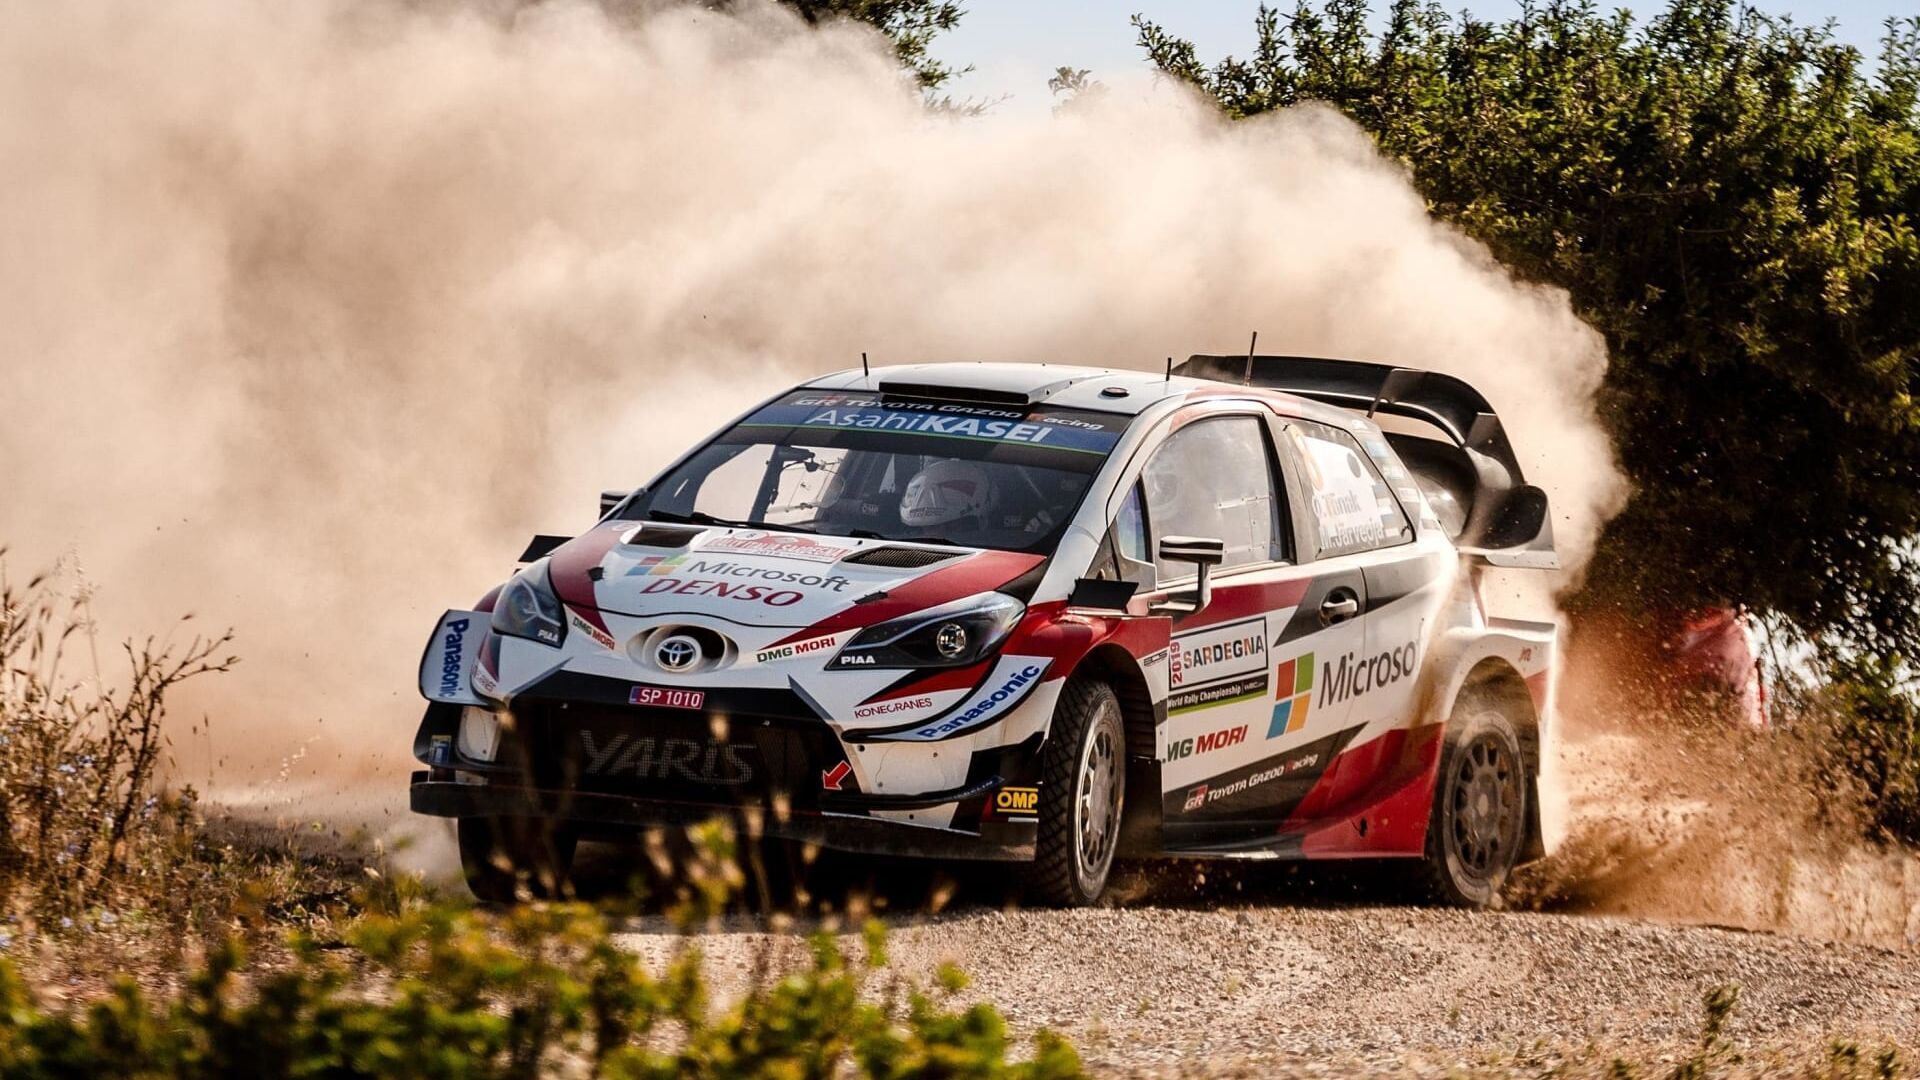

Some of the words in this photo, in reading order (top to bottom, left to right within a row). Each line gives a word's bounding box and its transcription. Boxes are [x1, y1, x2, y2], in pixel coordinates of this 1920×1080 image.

[846, 400, 934, 411] TOYOTA
[938, 404, 1023, 419] GAZOO
[687, 561, 850, 592] Microsoft
[640, 578, 804, 607] DENSO
[537, 628, 559, 643] PIAA
[572, 617, 592, 636] DMG
[592, 631, 616, 650] MORI
[438, 618, 470, 698] Panasonic
[757, 647, 793, 663] DMG
[795, 637, 836, 655] MORI
[841, 655, 876, 665] PIAA
[1170, 642, 1183, 684] 2019
[1183, 635, 1265, 670] SARDEGNA
[640, 690, 662, 703] SP
[665, 691, 701, 707] 1010
[854, 698, 933, 720] KONECRANES
[917, 665, 1040, 739] Panasonic
[1184, 693, 1200, 705] Rally
[1200, 684, 1241, 701] Championship
[580, 730, 757, 785] YARIS
[1161, 738, 1193, 763] MG
[1195, 725, 1249, 755] MORI
[1208, 779, 1247, 802] TOYOTA
[1249, 765, 1285, 787] GAZOO
[997, 791, 1039, 809] OMP
